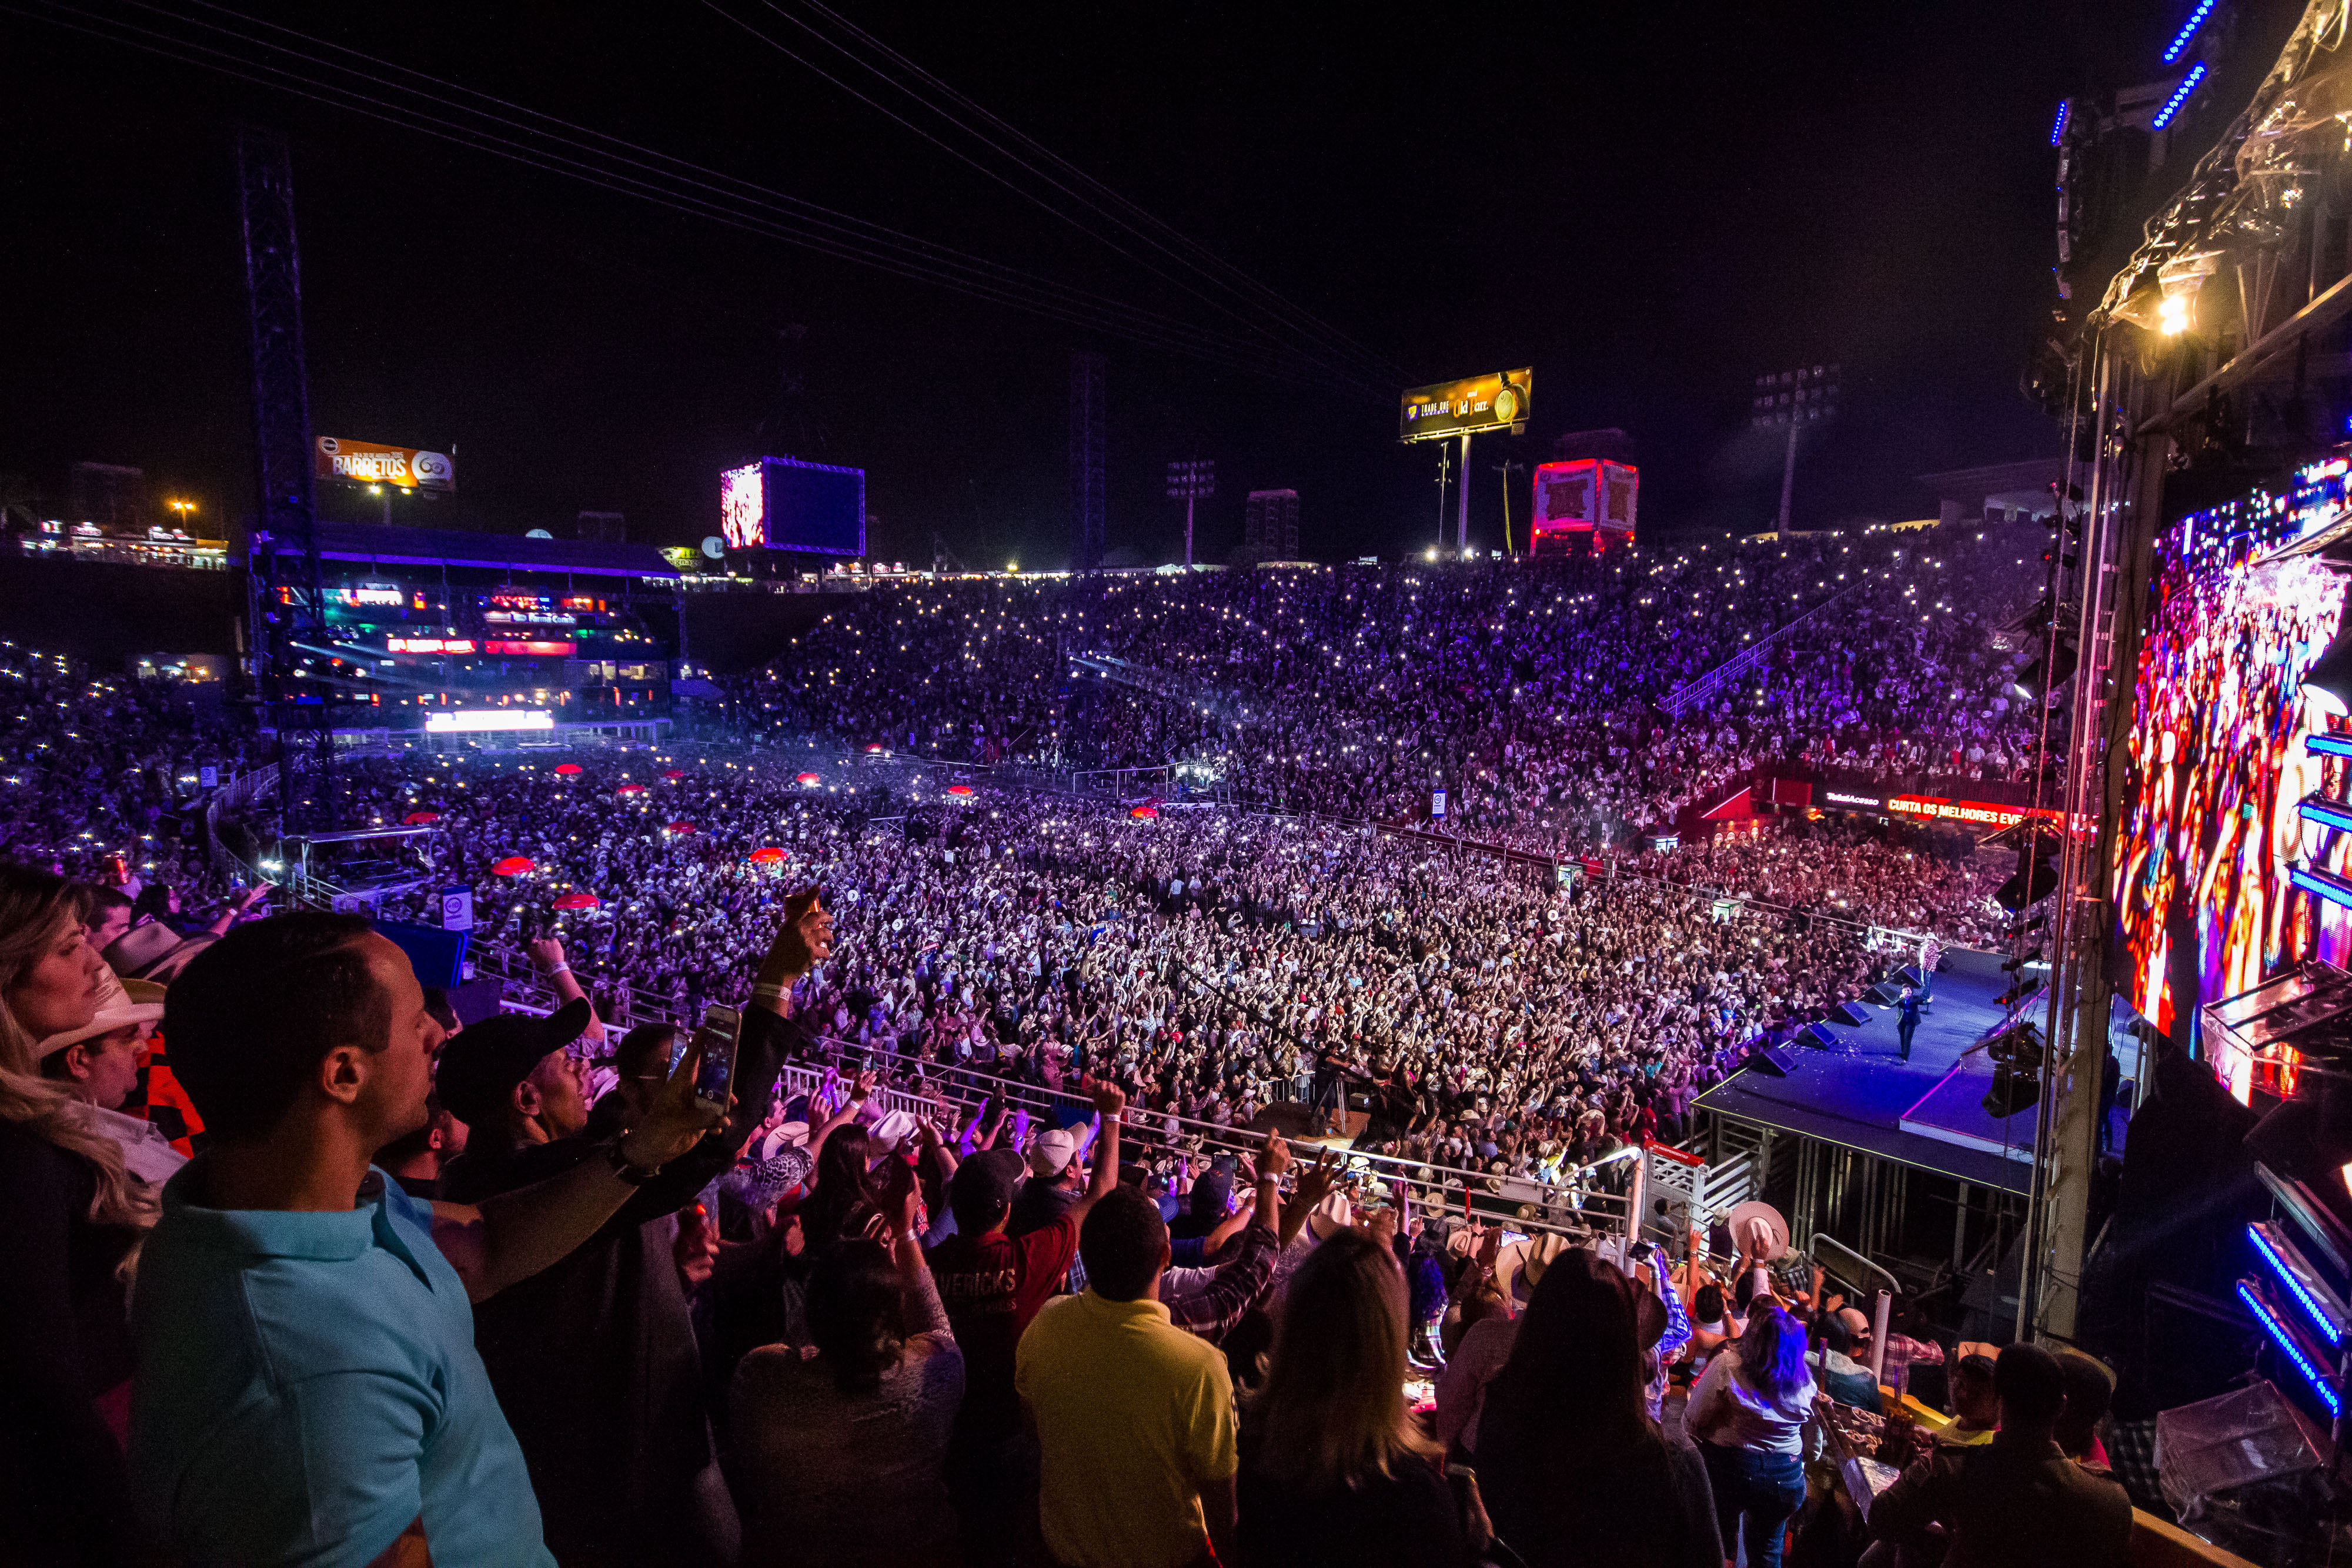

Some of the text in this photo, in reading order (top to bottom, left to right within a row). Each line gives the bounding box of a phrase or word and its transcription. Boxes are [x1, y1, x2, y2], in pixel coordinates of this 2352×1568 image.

[1422, 401, 1449, 413] TRADE ONE
[1454, 399, 1468, 418] Old
[333, 456, 406, 476] BARRETOS
[1889, 799, 1921, 813] CURTA
[1923, 803, 1937, 815] OS
[1939, 805, 1998, 823] MELHORES
